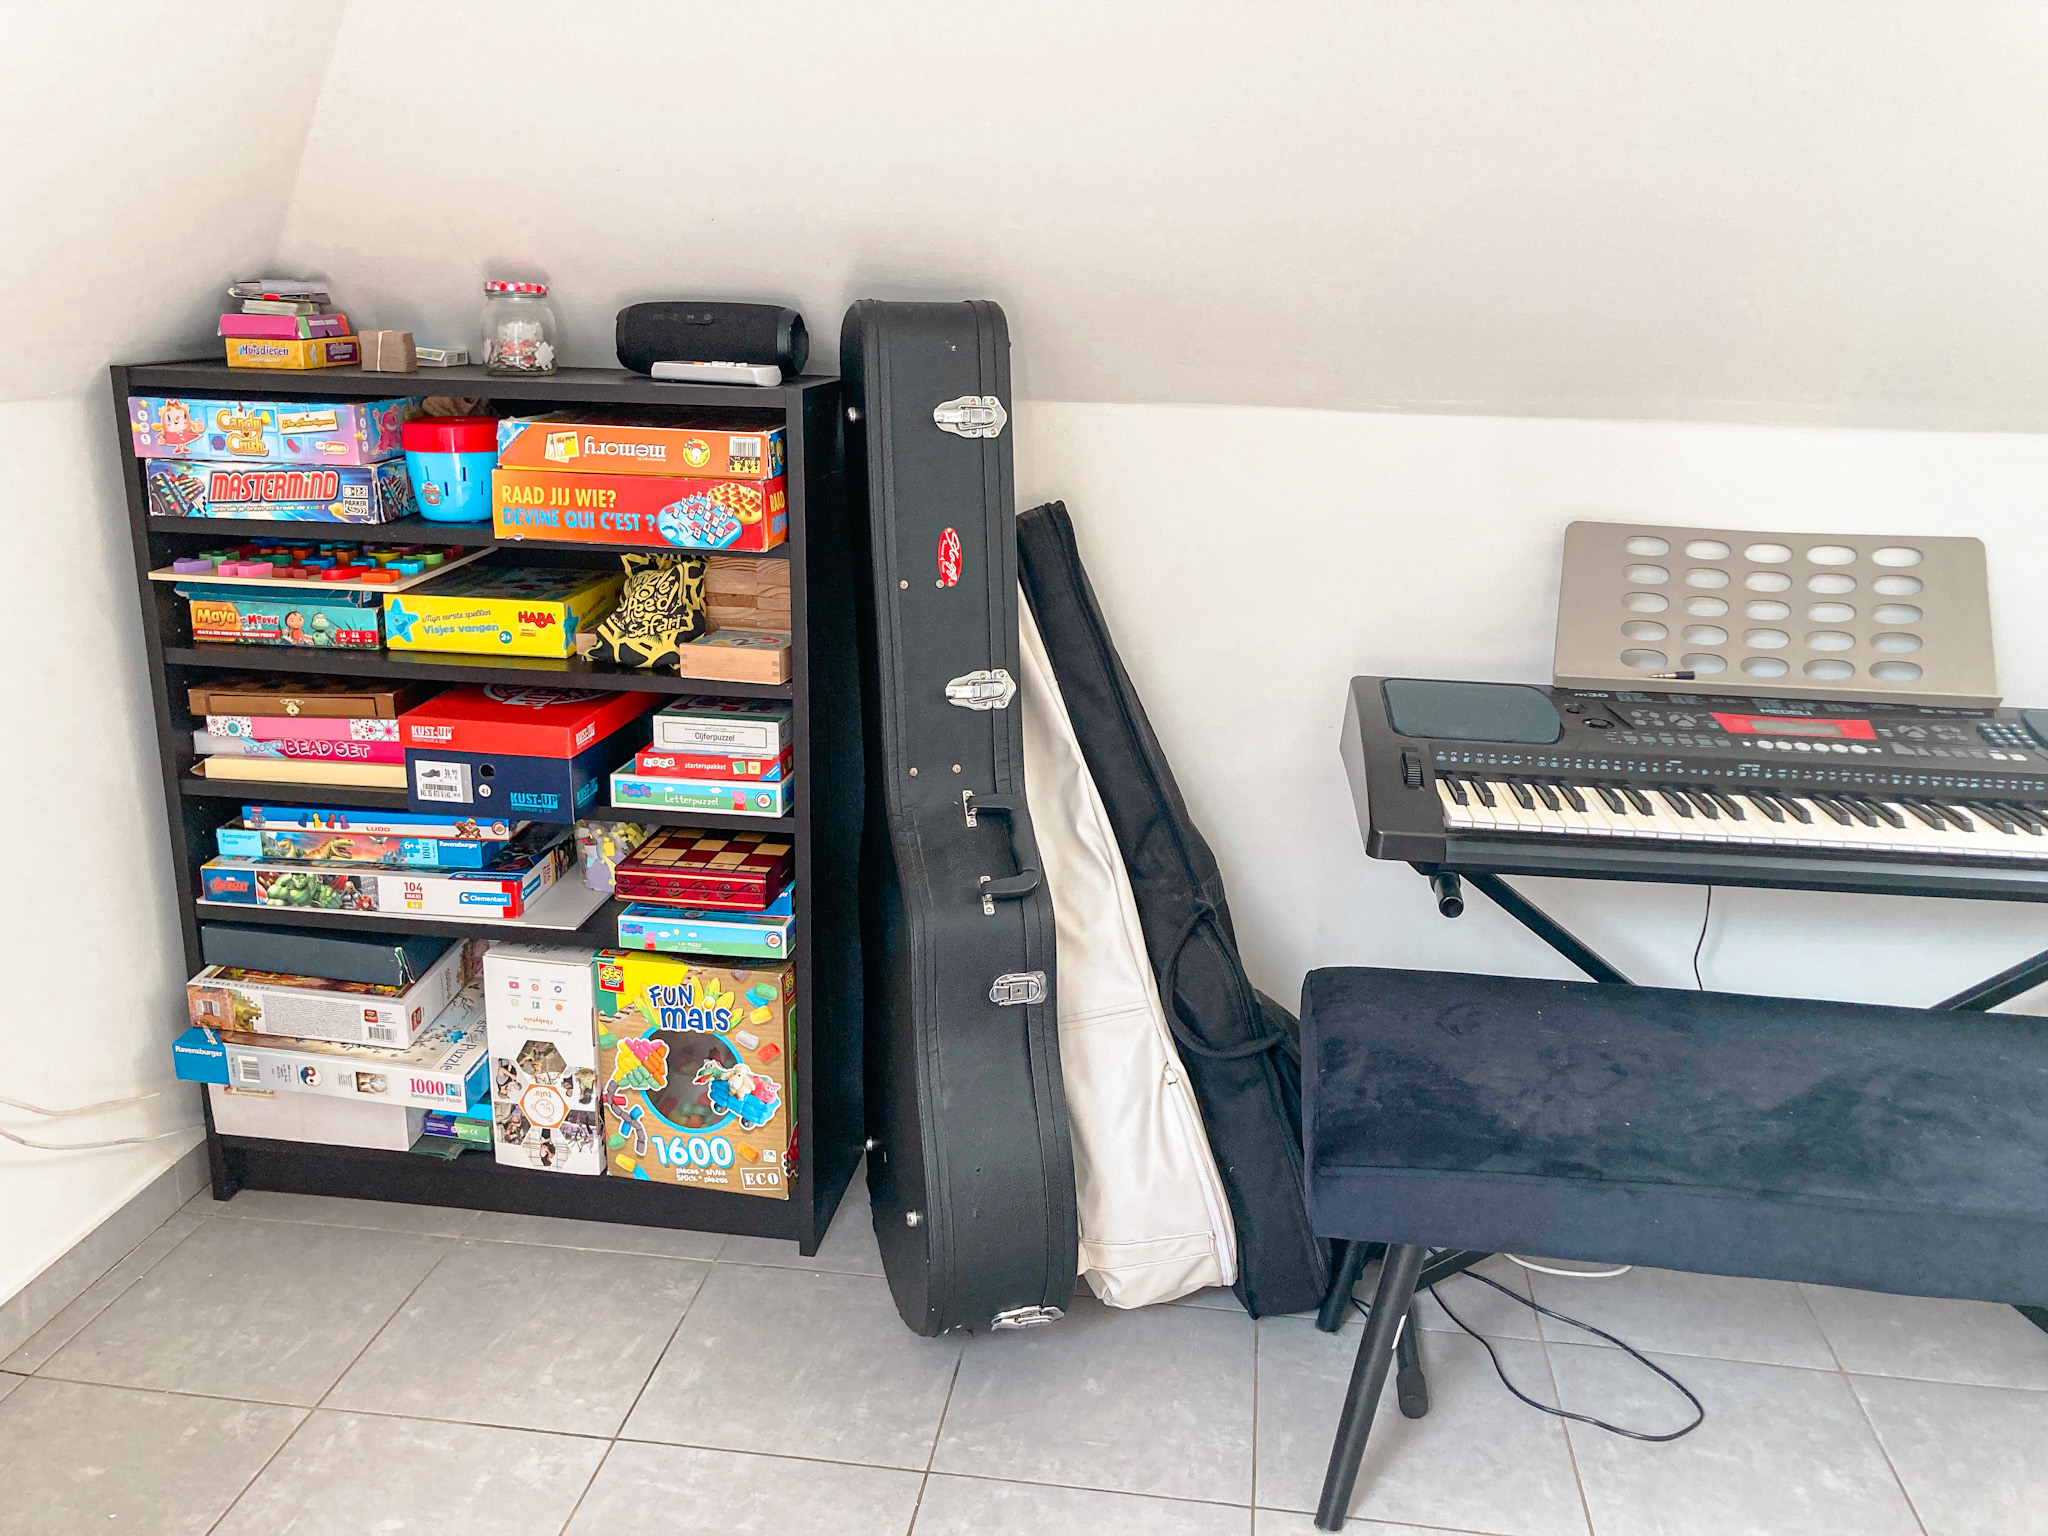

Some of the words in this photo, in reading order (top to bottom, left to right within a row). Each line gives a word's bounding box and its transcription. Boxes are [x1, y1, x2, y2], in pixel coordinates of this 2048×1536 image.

[240, 344, 289, 356] Huisdieren
[216, 408, 262, 438] Candy
[225, 431, 269, 456] Crush
[325, 443, 348, 452] Games
[584, 435, 666, 458] memory
[502, 485, 545, 504] RAAD
[549, 487, 570, 506] JIJ
[574, 488, 617, 508] WIE?
[502, 507, 560, 528] DEVINE
[564, 510, 595, 529] QUI
[599, 512, 641, 531] C'EST
[645, 513, 655, 532] ?
[196, 607, 236, 624] Maya
[422, 614, 441, 623] Mijn
[442, 612, 463, 620] eerste
[464, 609, 491, 619] spellen
[518, 611, 556, 628] HABA
[423, 624, 455, 636] Visjes
[458, 624, 499, 634] vangen
[500, 633, 511, 641] 2+
[1759, 708, 1813, 716] MEDELI
[411, 725, 452, 740] KUST-UP
[694, 733, 735, 742] Cijferpuzzel
[283, 739, 332, 756] BEAD
[335, 741, 370, 758] SET
[644, 757, 676, 768] LOCO
[684, 762, 727, 771] starterspakket
[510, 792, 558, 808] KUST-UP
[665, 793, 719, 807] Letterpuzzel
[404, 841, 415, 849] 6+
[439, 841, 478, 849] Ravensburger
[404, 882, 422, 892] 104
[470, 894, 508, 904] Clementoni
[602, 966, 623, 982] SES
[648, 983, 694, 1007] FUN
[658, 1004, 733, 1033] mais
[175, 1045, 223, 1058] Ravensburger
[440, 1043, 477, 1071] Puzzle
[409, 1078, 445, 1096] 1000
[535, 1090, 551, 1098] tula
[411, 1092, 445, 1102] Ravensburger
[651, 1135, 733, 1167] 1600
[745, 1172, 779, 1186] ECO
